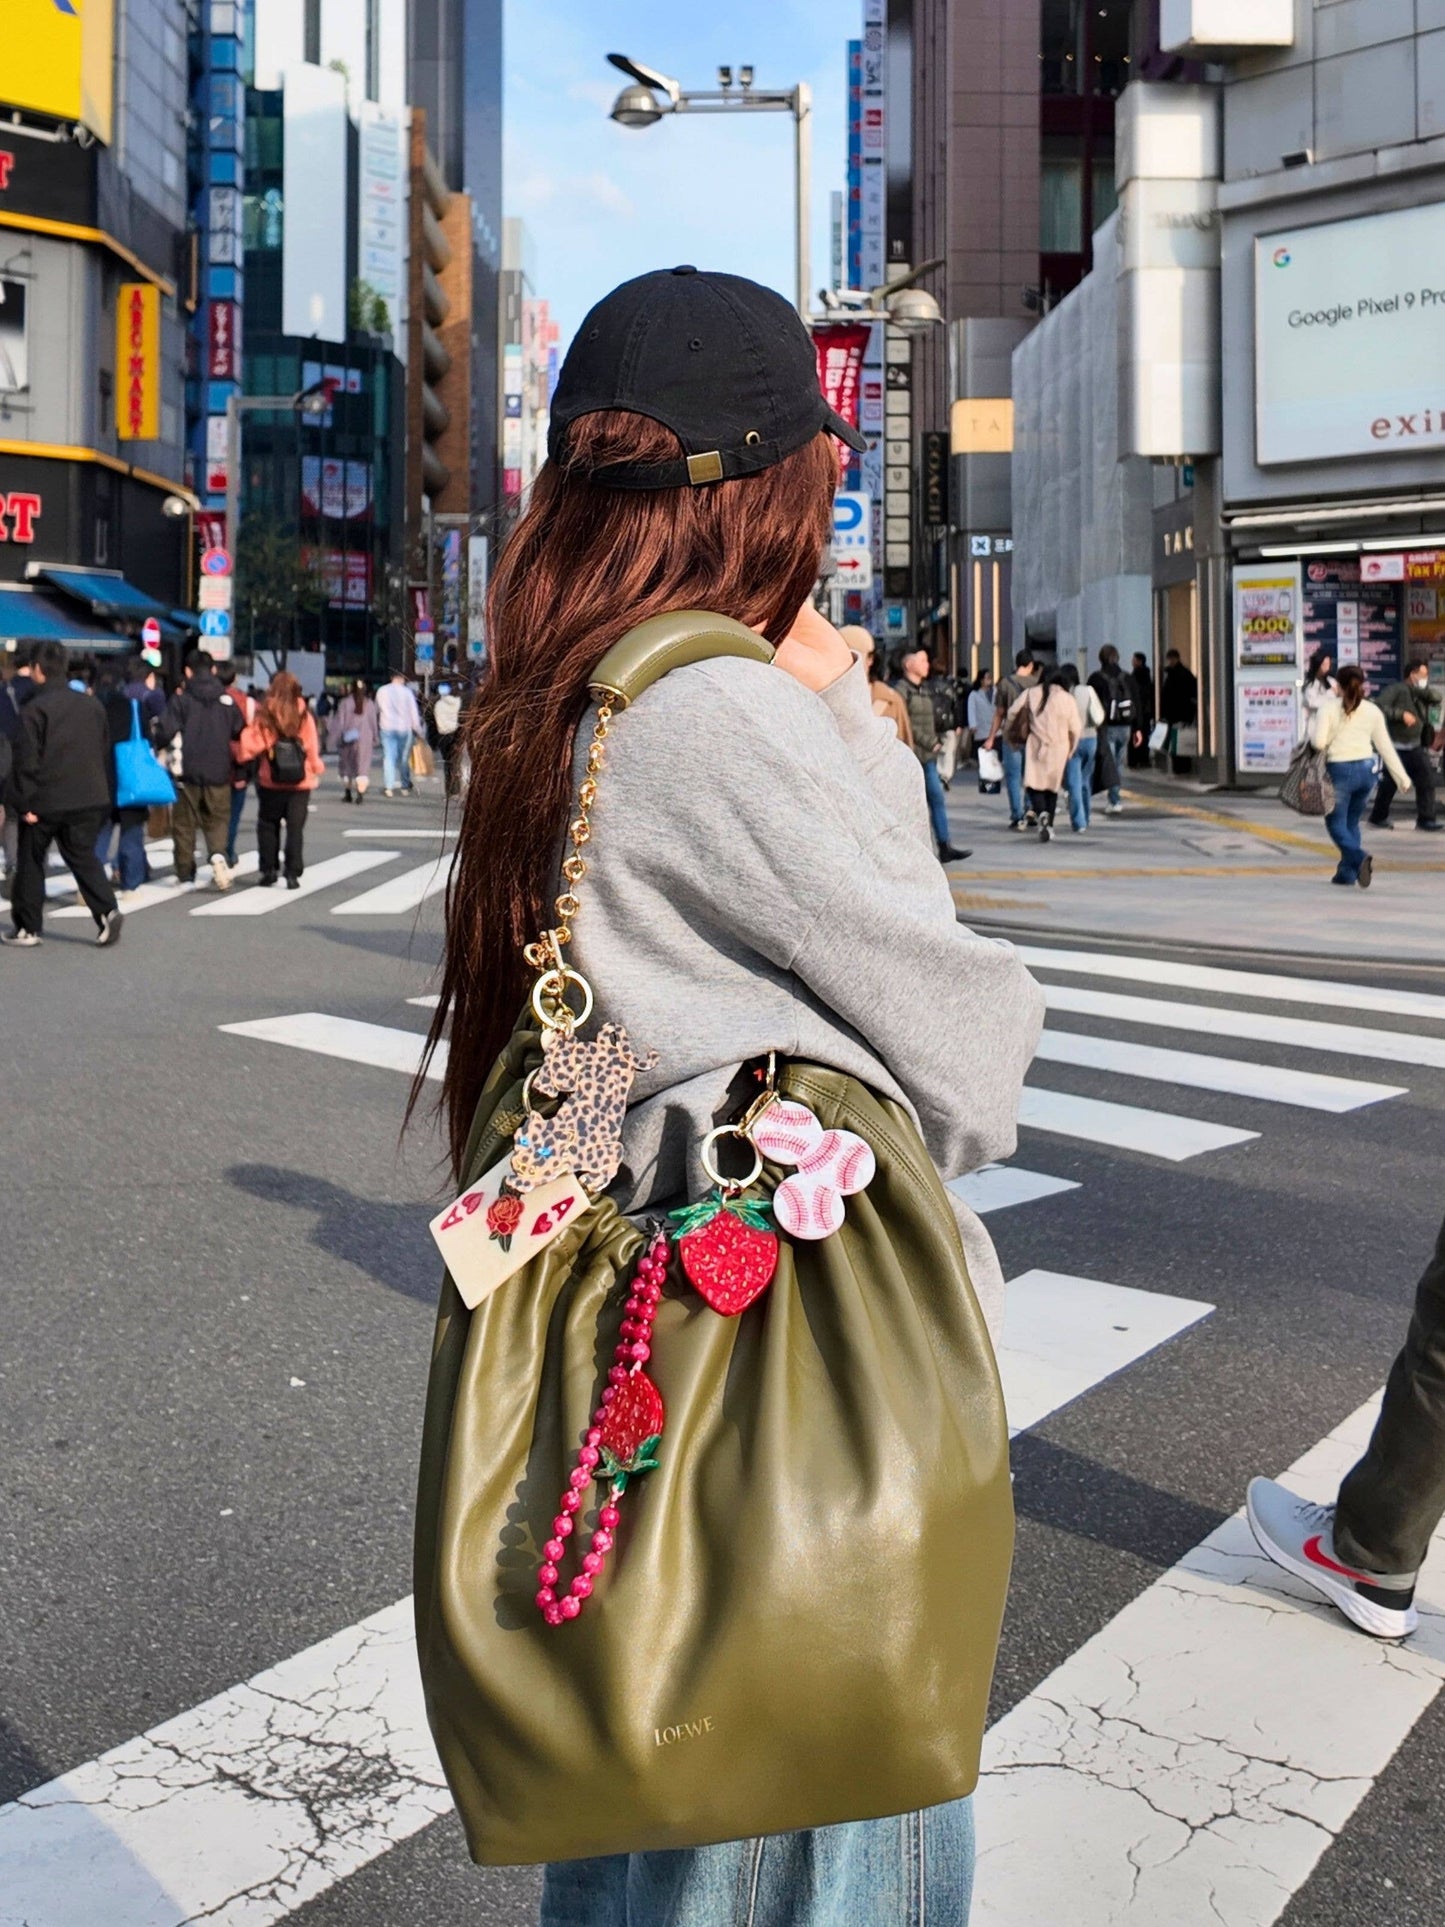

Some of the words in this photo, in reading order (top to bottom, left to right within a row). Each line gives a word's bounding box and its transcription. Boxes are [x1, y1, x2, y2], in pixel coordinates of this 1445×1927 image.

[1288, 304, 1352, 328] Google
[1357, 294, 1399, 317] Pixel
[1404, 291, 1415, 309] 9
[0, 492, 42, 543] T
[1163, 526, 1194, 556] TAK
[551, 1196, 575, 1221] A
[654, 1716, 714, 1746] LOEWE
